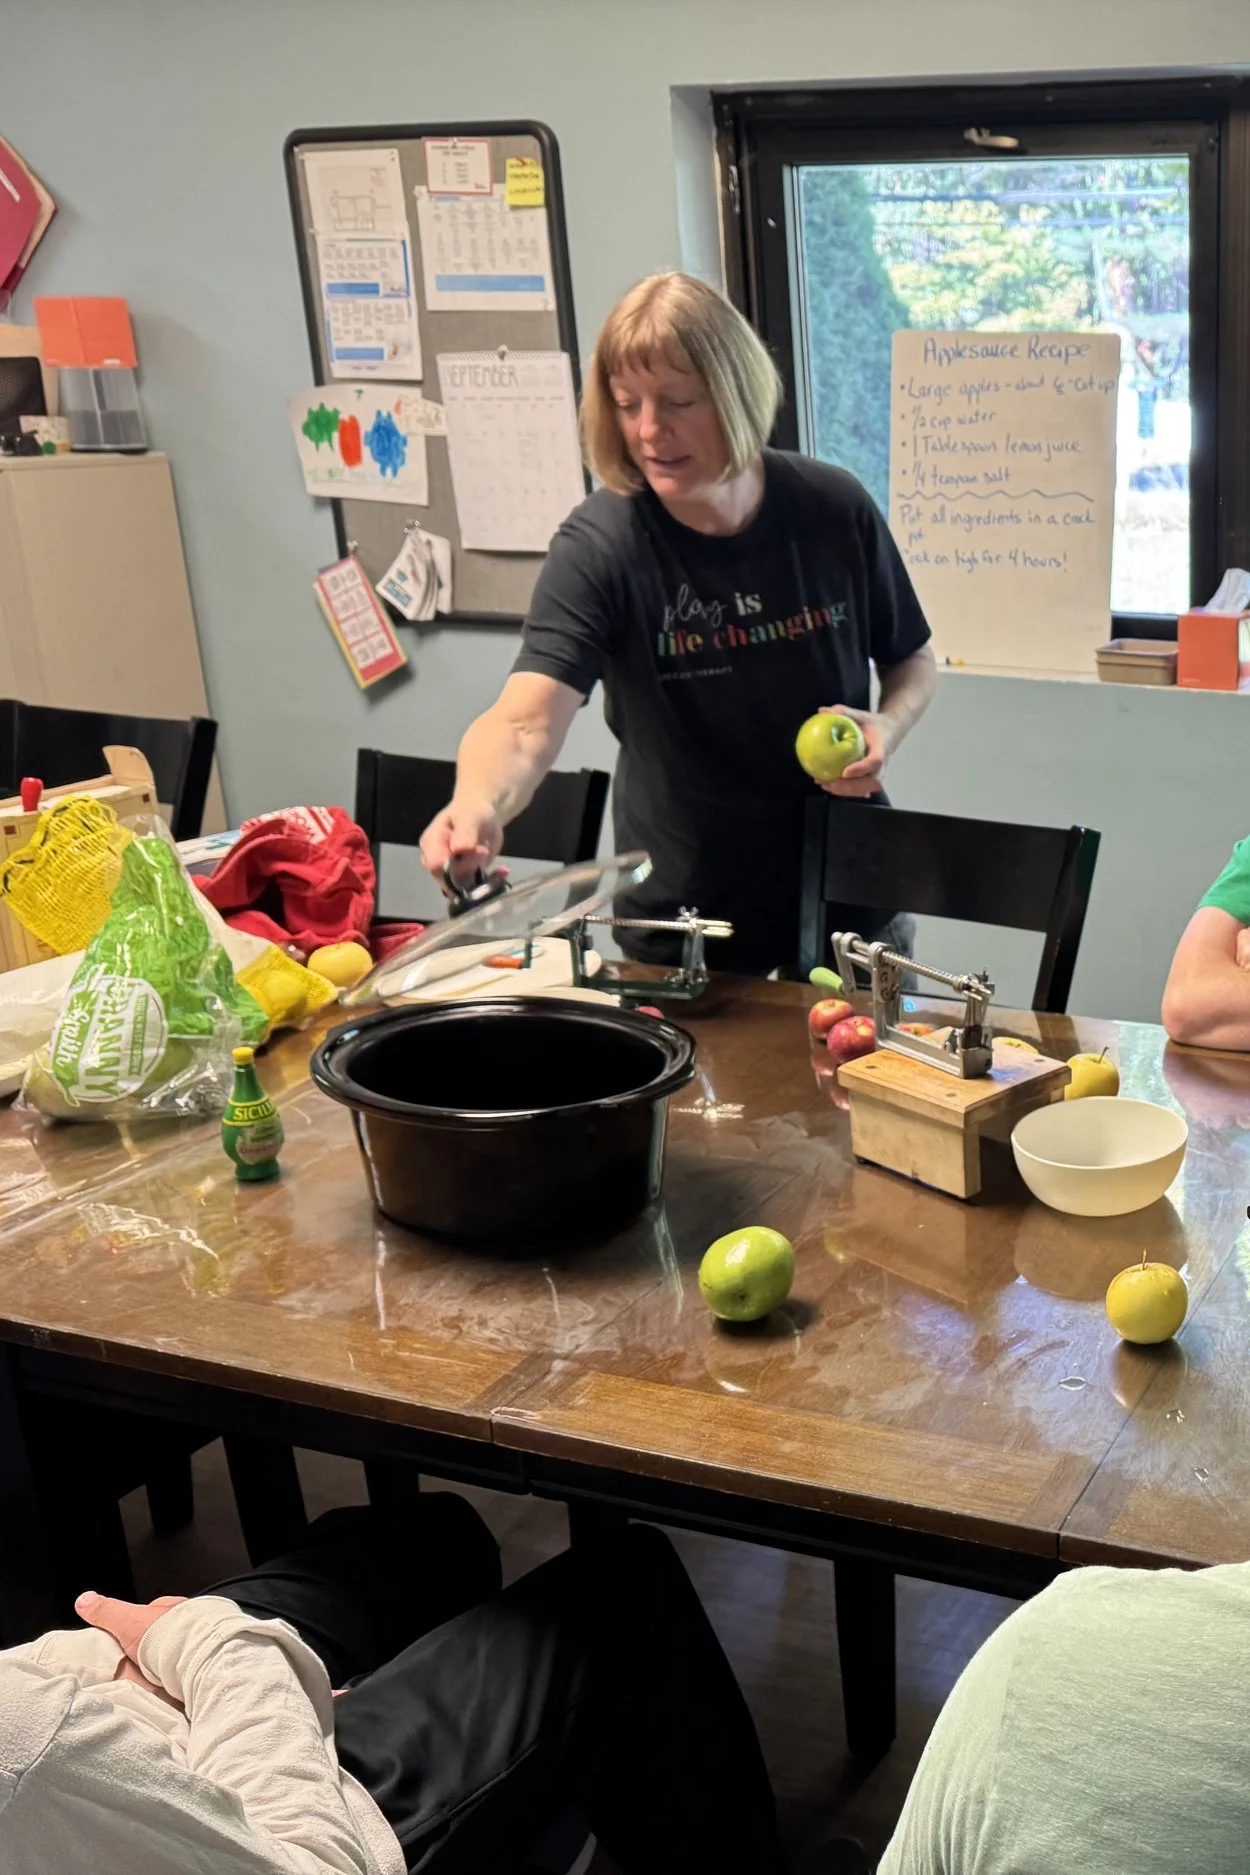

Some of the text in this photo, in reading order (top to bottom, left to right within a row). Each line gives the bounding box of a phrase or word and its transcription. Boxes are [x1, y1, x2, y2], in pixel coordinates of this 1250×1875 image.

[1027, 334, 1091, 366] Recipe
[908, 376, 952, 406] Large
[930, 414, 952, 430] cup
[956, 410, 998, 426] water
[983, 466, 1012, 484] salt
[900, 504, 924, 525] Put
[951, 507, 1022, 533] ingredients
[1028, 510, 1042, 523] in
[1047, 515, 1058, 525] a
[935, 555, 949, 564] on
[1008, 549, 1018, 567] 4
[734, 592, 763, 616] is
[713, 601, 848, 650] changing
[56, 1007, 90, 1067] Smith
